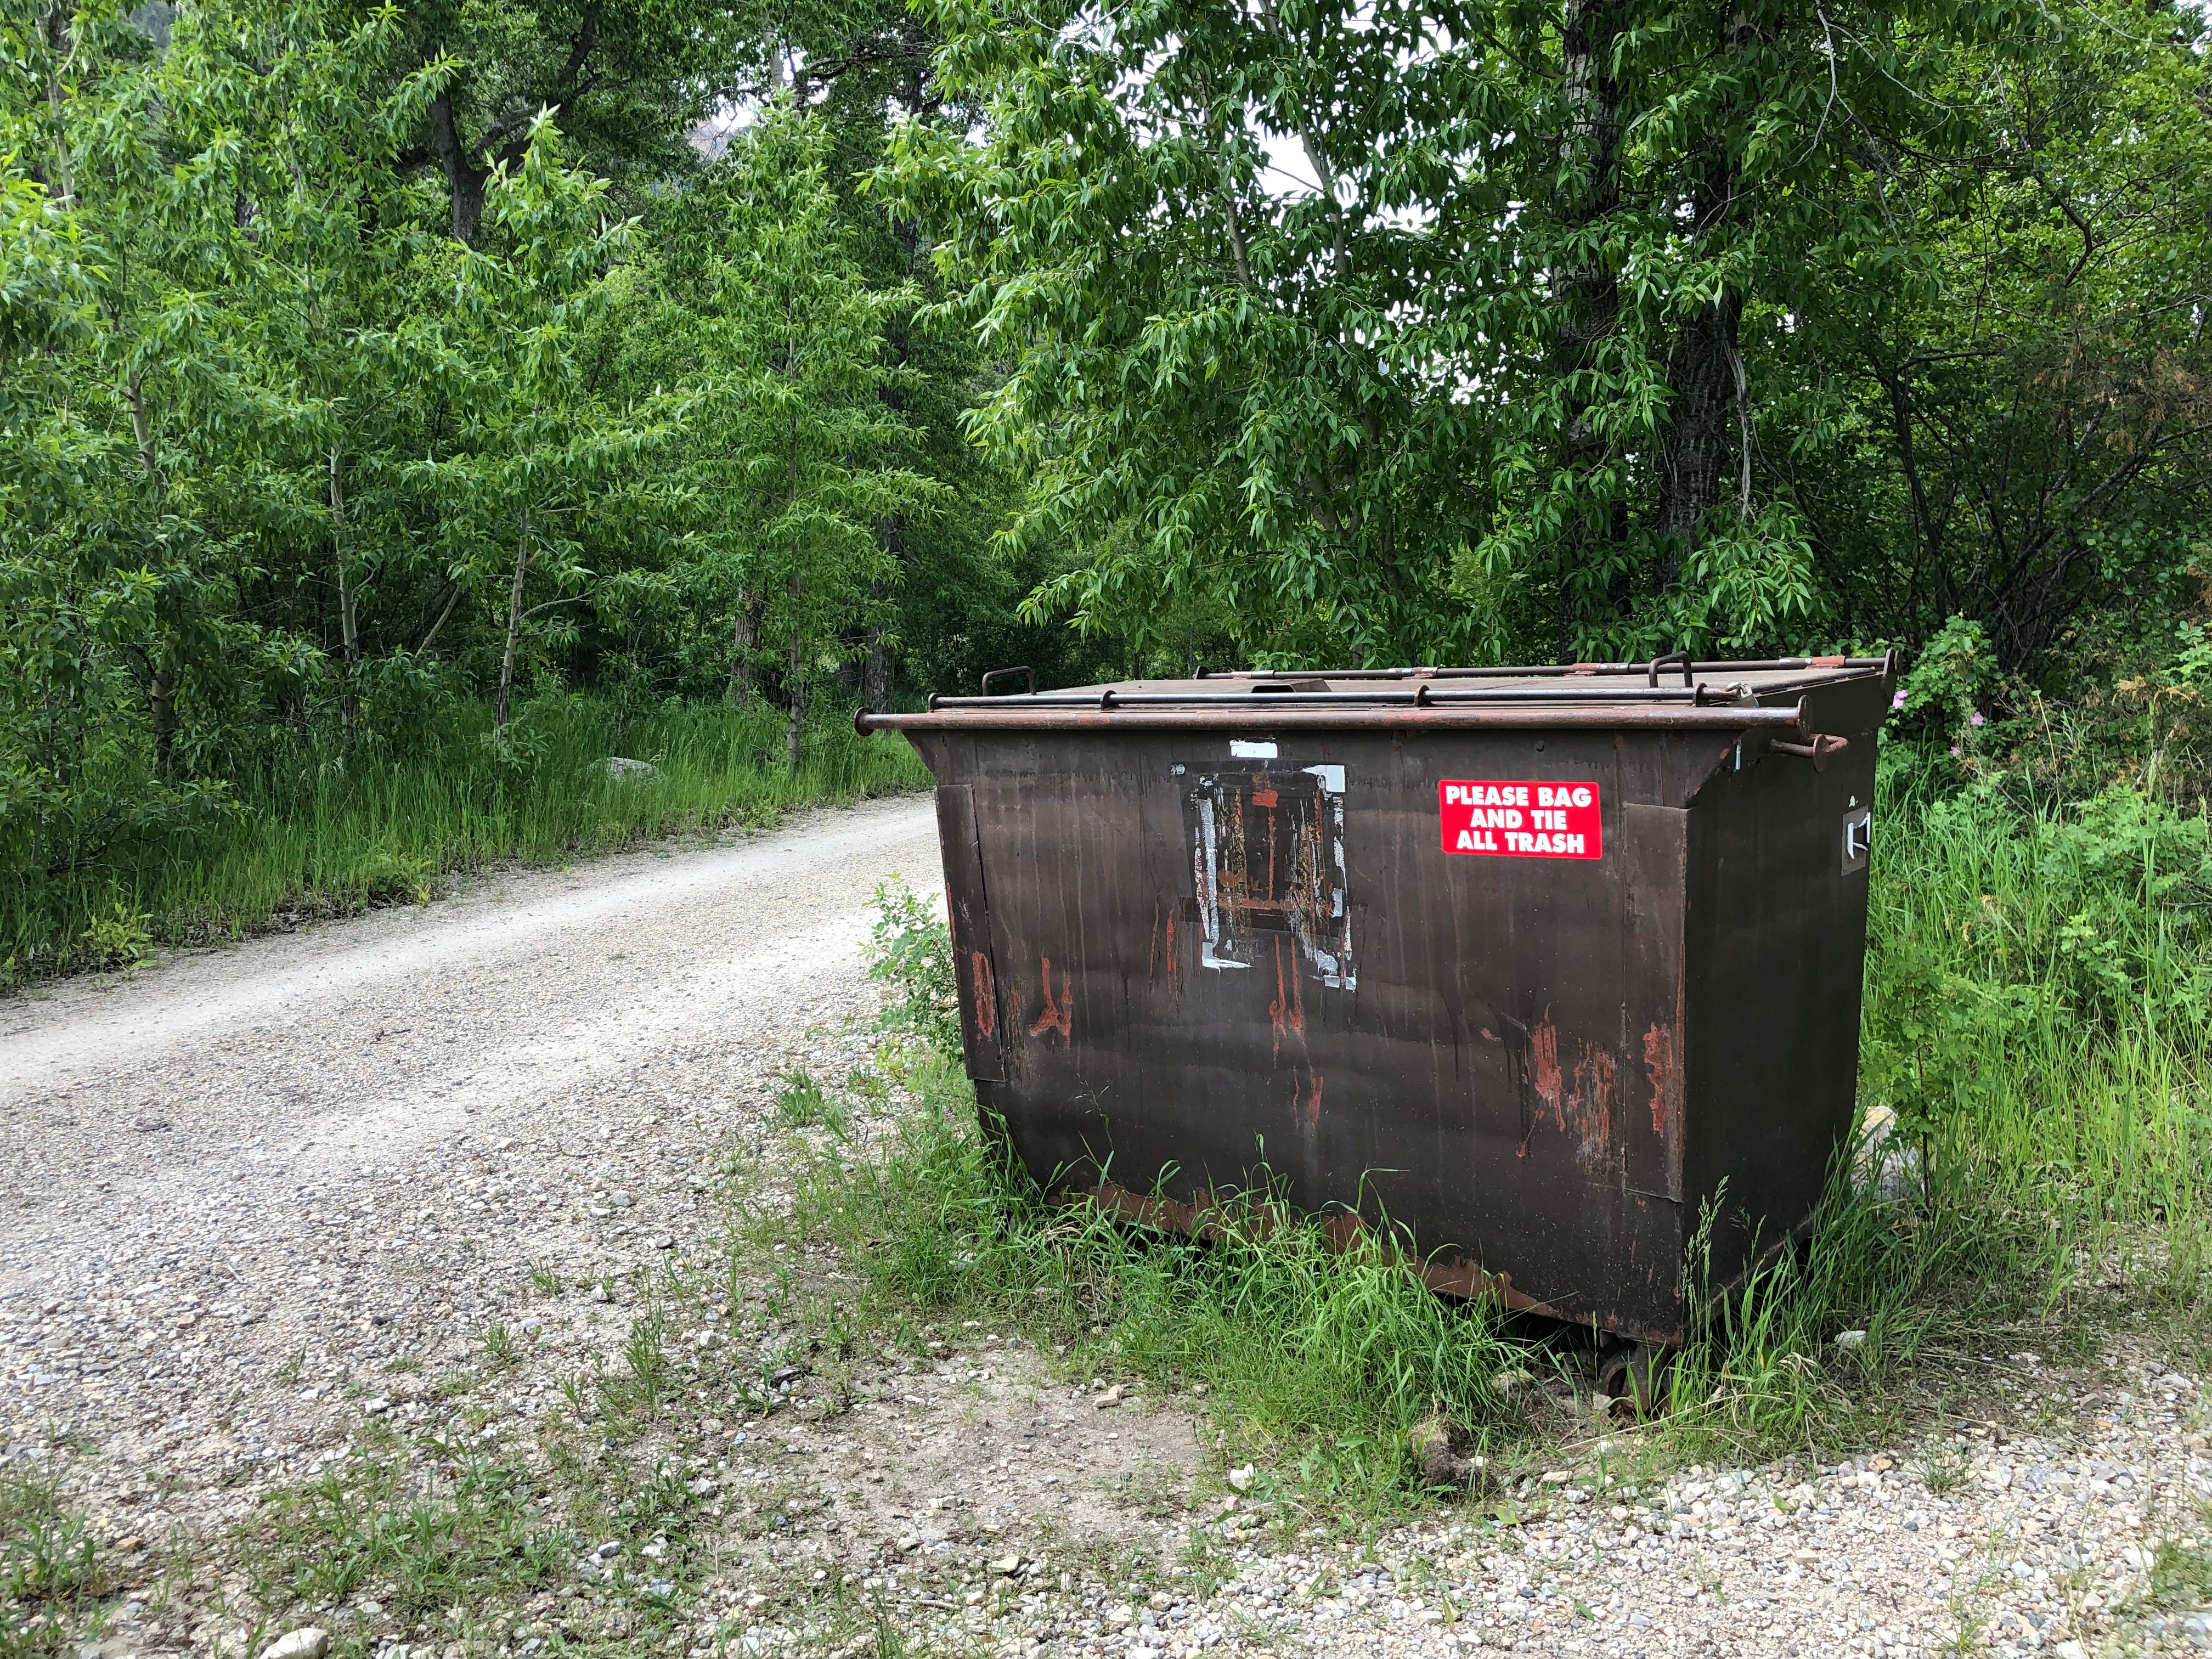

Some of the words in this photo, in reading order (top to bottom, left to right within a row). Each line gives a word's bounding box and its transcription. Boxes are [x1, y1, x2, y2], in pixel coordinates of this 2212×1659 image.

[1446, 785, 1529, 806] PLEASE
[1538, 787, 1592, 807] BAG
[1470, 808, 1522, 828] AND
[1531, 809, 1567, 830] TIE
[1457, 830, 1497, 850] ALL
[1505, 831, 1584, 854] TRASH
